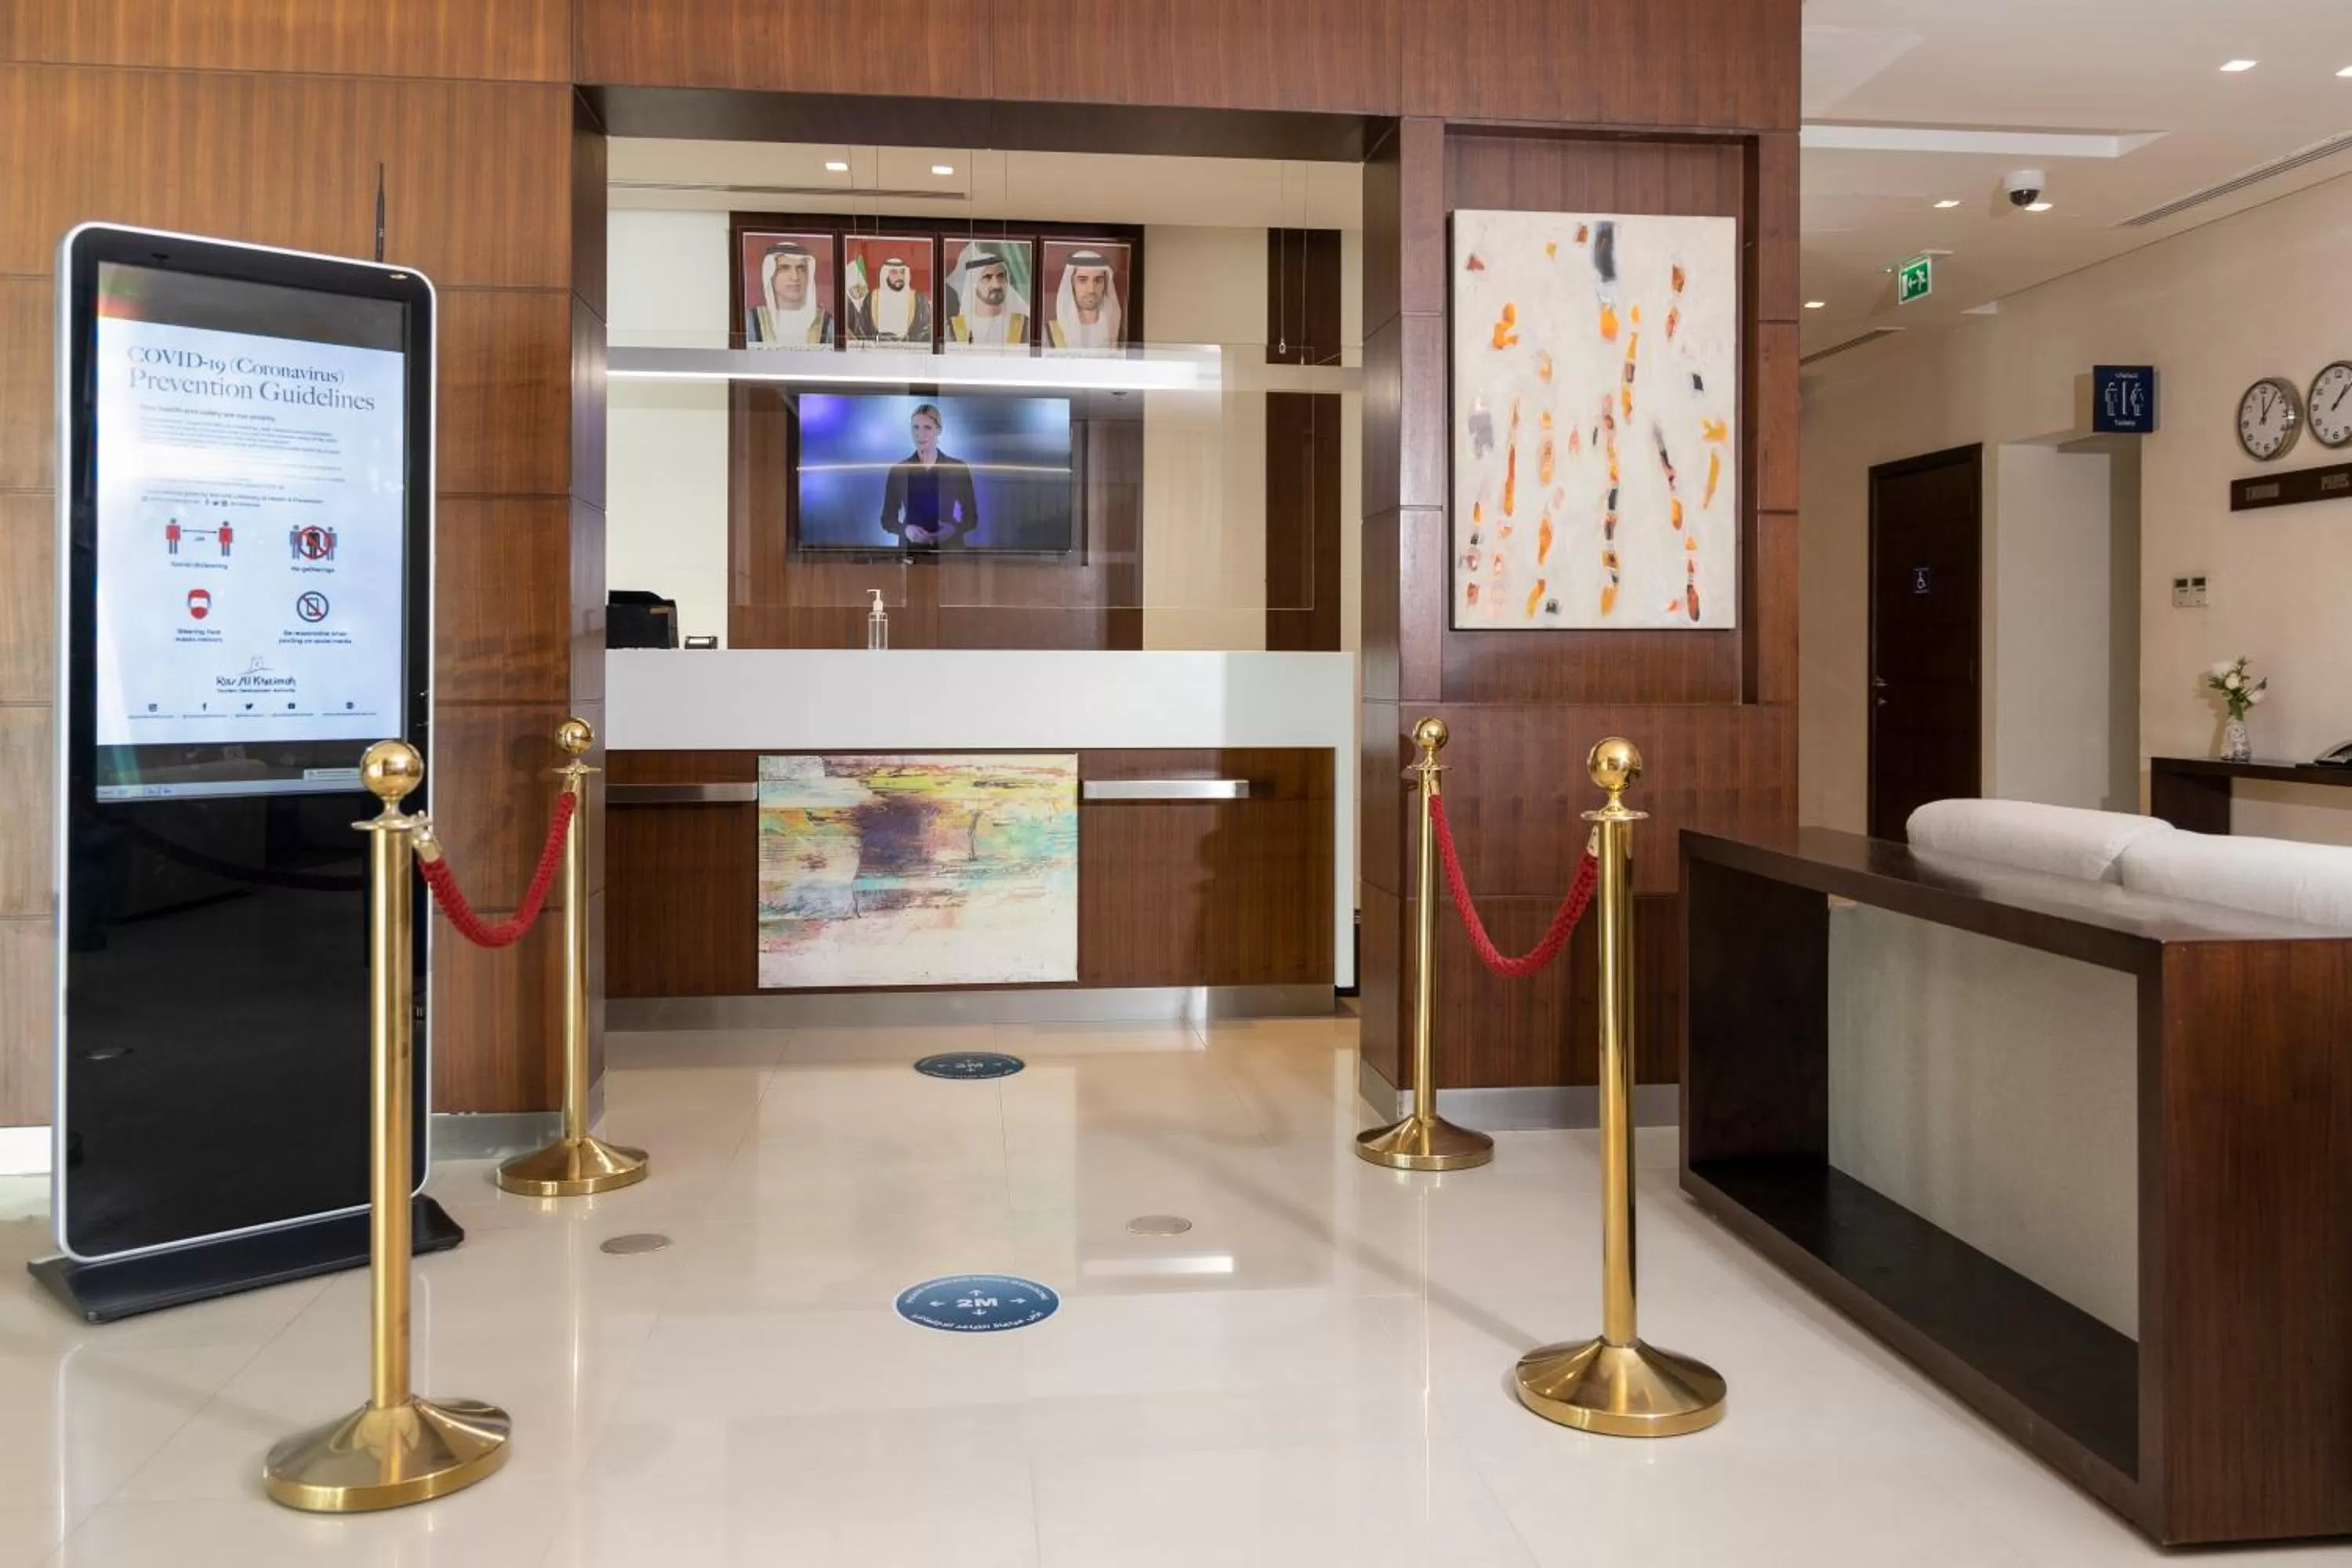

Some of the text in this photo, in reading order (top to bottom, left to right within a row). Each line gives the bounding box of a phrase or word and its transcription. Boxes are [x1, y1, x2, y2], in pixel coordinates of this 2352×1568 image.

[127, 345, 346, 384] COVID-19 (Coronavirus)
[129, 367, 376, 411] Prevention Guidelines
[956, 1298, 999, 1308] 2M
